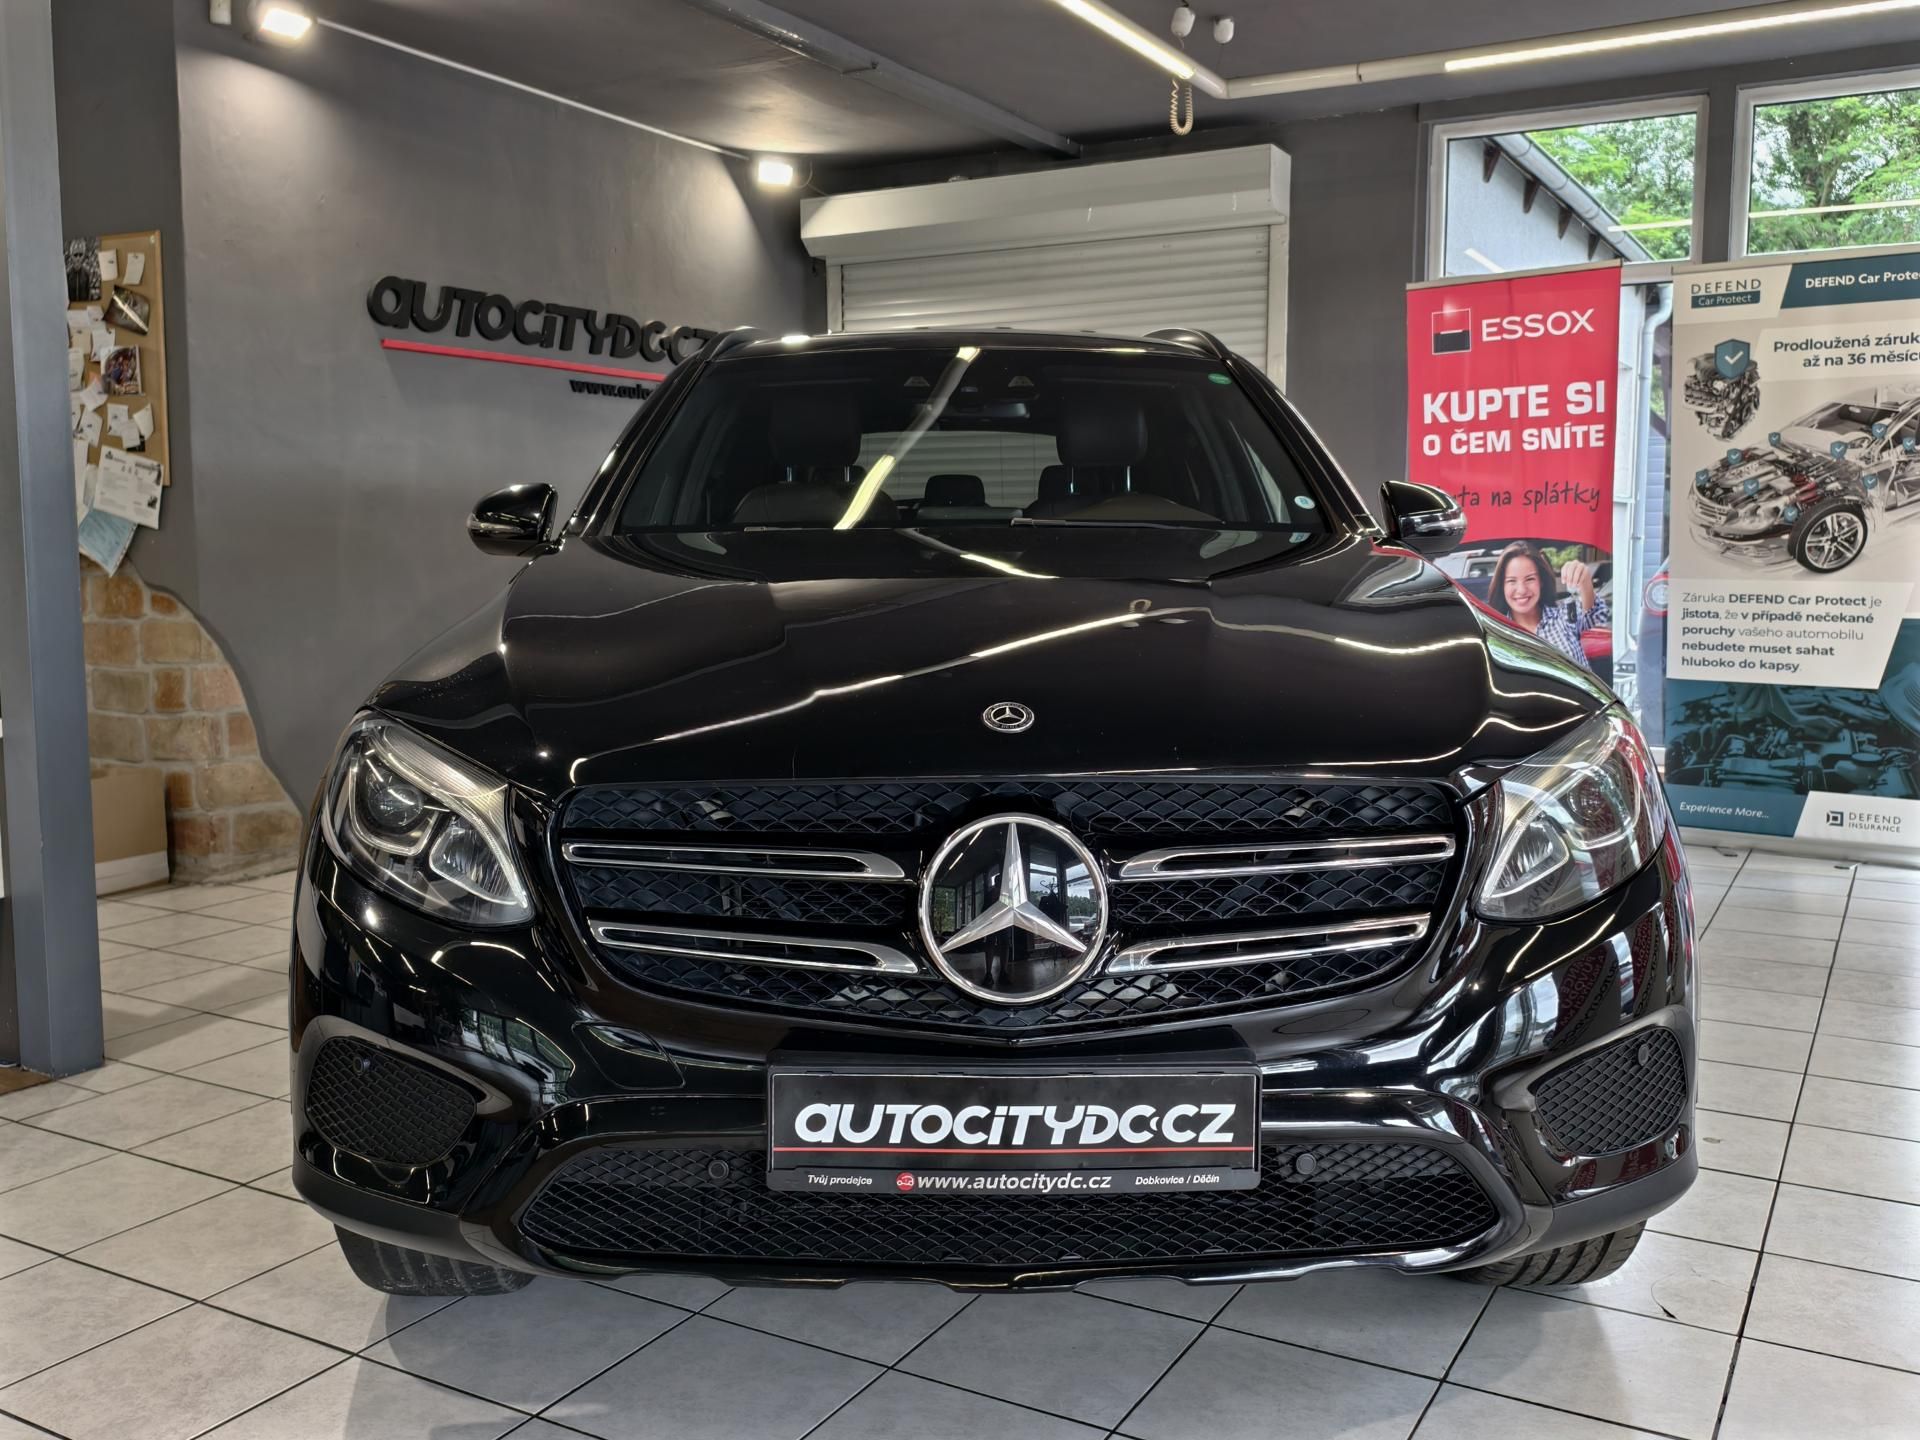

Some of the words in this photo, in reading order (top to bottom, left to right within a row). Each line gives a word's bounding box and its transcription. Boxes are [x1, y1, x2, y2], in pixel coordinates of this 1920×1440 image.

[1691, 278, 1761, 295] DEFEND
[1804, 274, 1855, 289] DEFEND
[1858, 272, 1880, 285] Car
[1883, 270, 1920, 283] Prote
[1698, 296, 1715, 306] Car
[1716, 293, 1752, 305] Protect
[1481, 308, 1595, 342] ESSOX
[1773, 333, 1870, 353] Prodloužená
[1803, 355, 1821, 368] až
[1824, 355, 1843, 367] na
[1847, 352, 1866, 365] 36
[1870, 348, 1920, 364] měsíc
[1423, 384, 1549, 425] KUPTE
[1566, 380, 1605, 415] SI
[1423, 434, 1440, 456] O
[1450, 428, 1511, 455] ČEM
[1522, 421, 1605, 451] SNÍTE
[1491, 489, 1512, 507] na
[1523, 480, 1600, 513] splátky
[1682, 592, 1725, 603] Záruka
[1728, 593, 1785, 605] DEFEND
[1788, 595, 1811, 606] Car
[1815, 595, 1867, 607] Protect
[1868, 596, 1882, 609] je
[1724, 608, 1738, 620] že
[1741, 611, 1749, 620] v
[1751, 609, 1803, 624] případě
[1806, 610, 1875, 624] nečekané
[1682, 624, 1736, 638] poruchy
[1738, 625, 1783, 638] vašeho
[1785, 628, 1864, 641] automobilu
[1681, 641, 1745, 653] nebudete
[1749, 644, 1793, 655] muset
[1795, 645, 1835, 656] sahat
[1681, 656, 1735, 669] hluboko
[1739, 658, 1756, 669] do
[1679, 801, 1733, 816] Experience
[1735, 807, 1769, 819] More...
[1848, 811, 1902, 825] DEFEND
[1848, 821, 1901, 833] INSURANCE
[807, 1174, 828, 1186] Tvůj
[829, 1175, 873, 1187] prodejce
[917, 1172, 1112, 1193] www.autocitydc.cz
[1135, 1175, 1184, 1186] Dobkovice
[1186, 1175, 1191, 1184] /
[1193, 1174, 1220, 1184] Děčín
